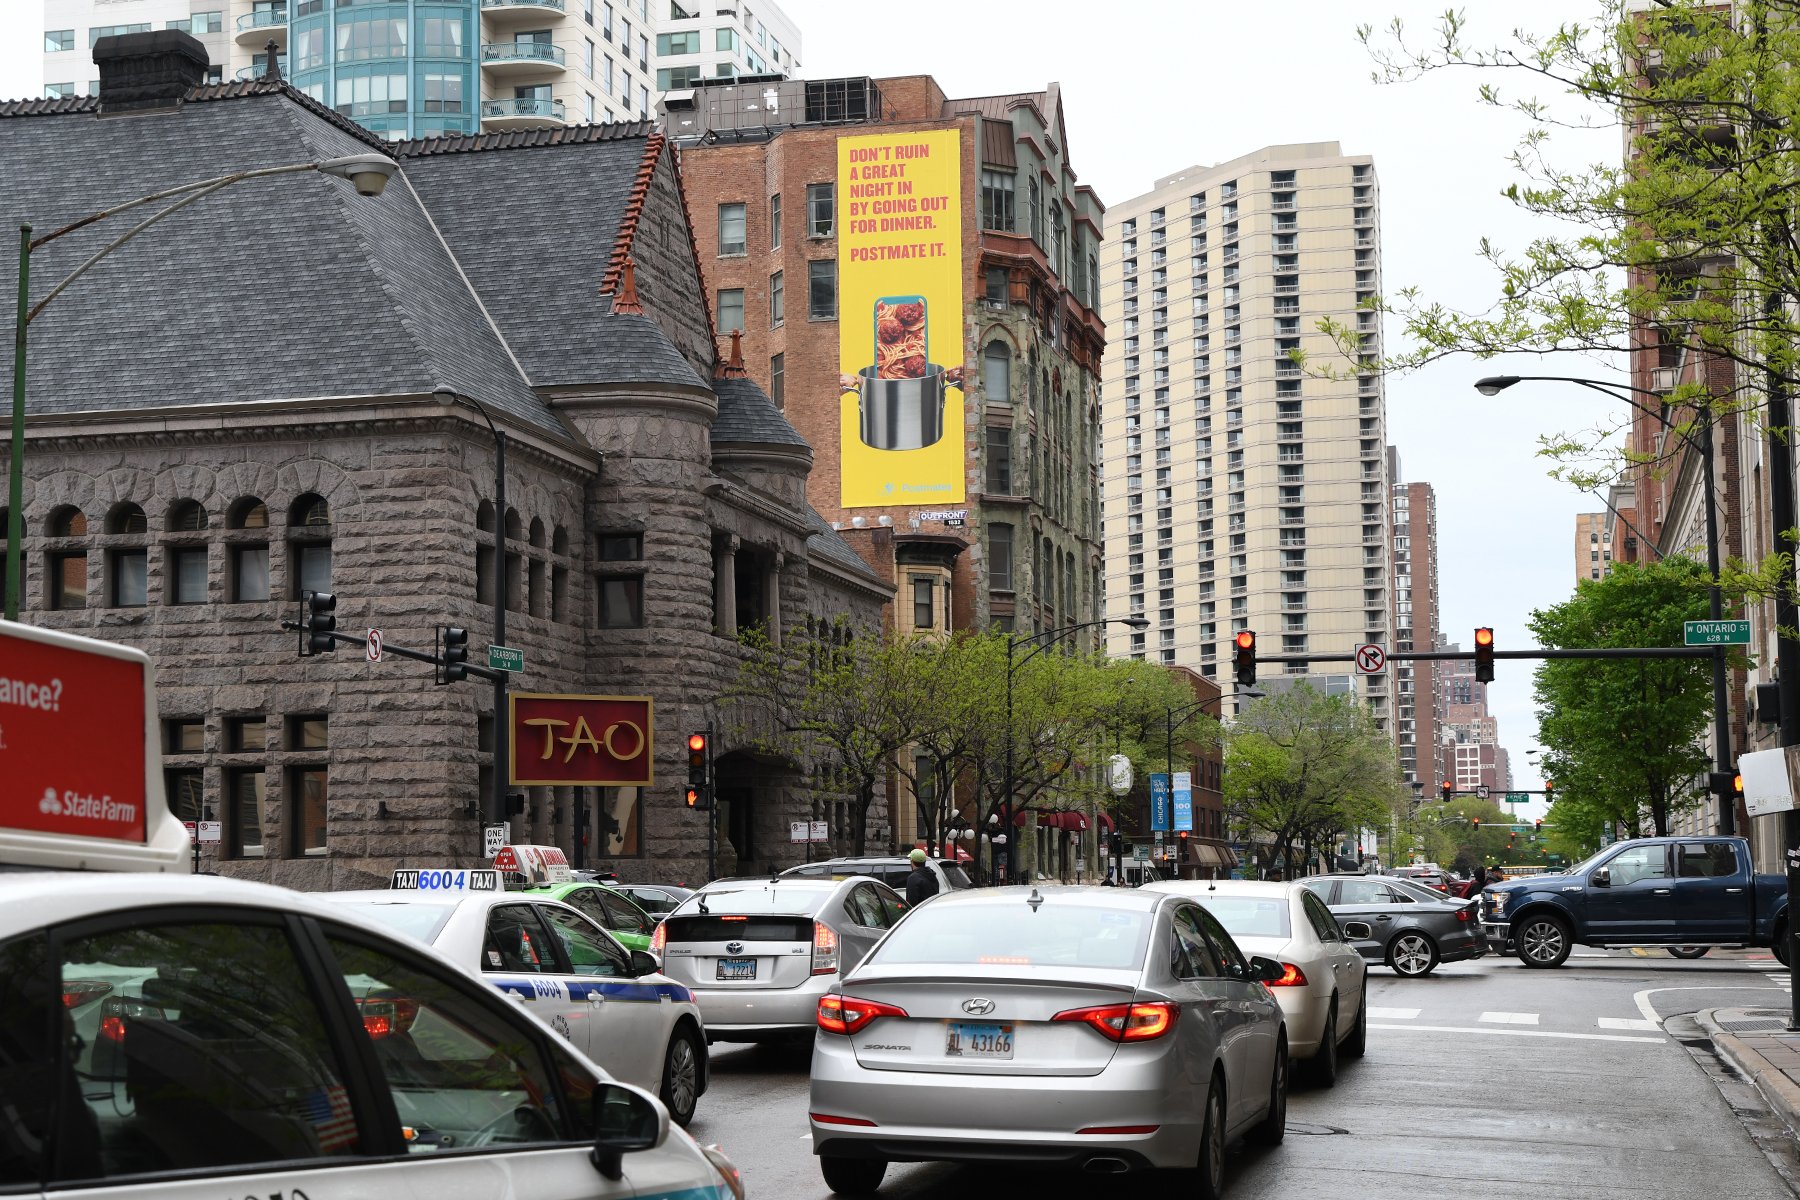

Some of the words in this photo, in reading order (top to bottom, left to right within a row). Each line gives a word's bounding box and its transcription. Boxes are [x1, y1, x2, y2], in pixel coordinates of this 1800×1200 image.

[850, 147, 891, 162] DON'T
[895, 144, 929, 159] RUIN
[850, 167, 858, 180] A
[862, 164, 906, 180] GREAT
[850, 182, 894, 198] NIGHT
[898, 181, 912, 195] IN
[850, 202, 868, 216] BY
[873, 199, 917, 214] GOING
[920, 197, 949, 211] OUT
[850, 219, 877, 234] FOR
[881, 216, 936, 232] DINNER.
[851, 244, 926, 262] POSTMATE
[930, 243, 946, 256] IT.
[1696, 624, 1736, 633] ONTARIO
[493, 649, 518, 661] DEARBORN
[522, 716, 644, 764] TAO
[487, 837, 503, 845] WAY
[488, 829, 502, 837] ONE
[396, 873, 418, 889] TAXI
[419, 871, 464, 890] 6004
[471, 872, 494, 889] TAXI
[732, 964, 754, 976] 12214
[534, 979, 561, 999] 6004
[972, 1034, 1010, 1052] 43166
